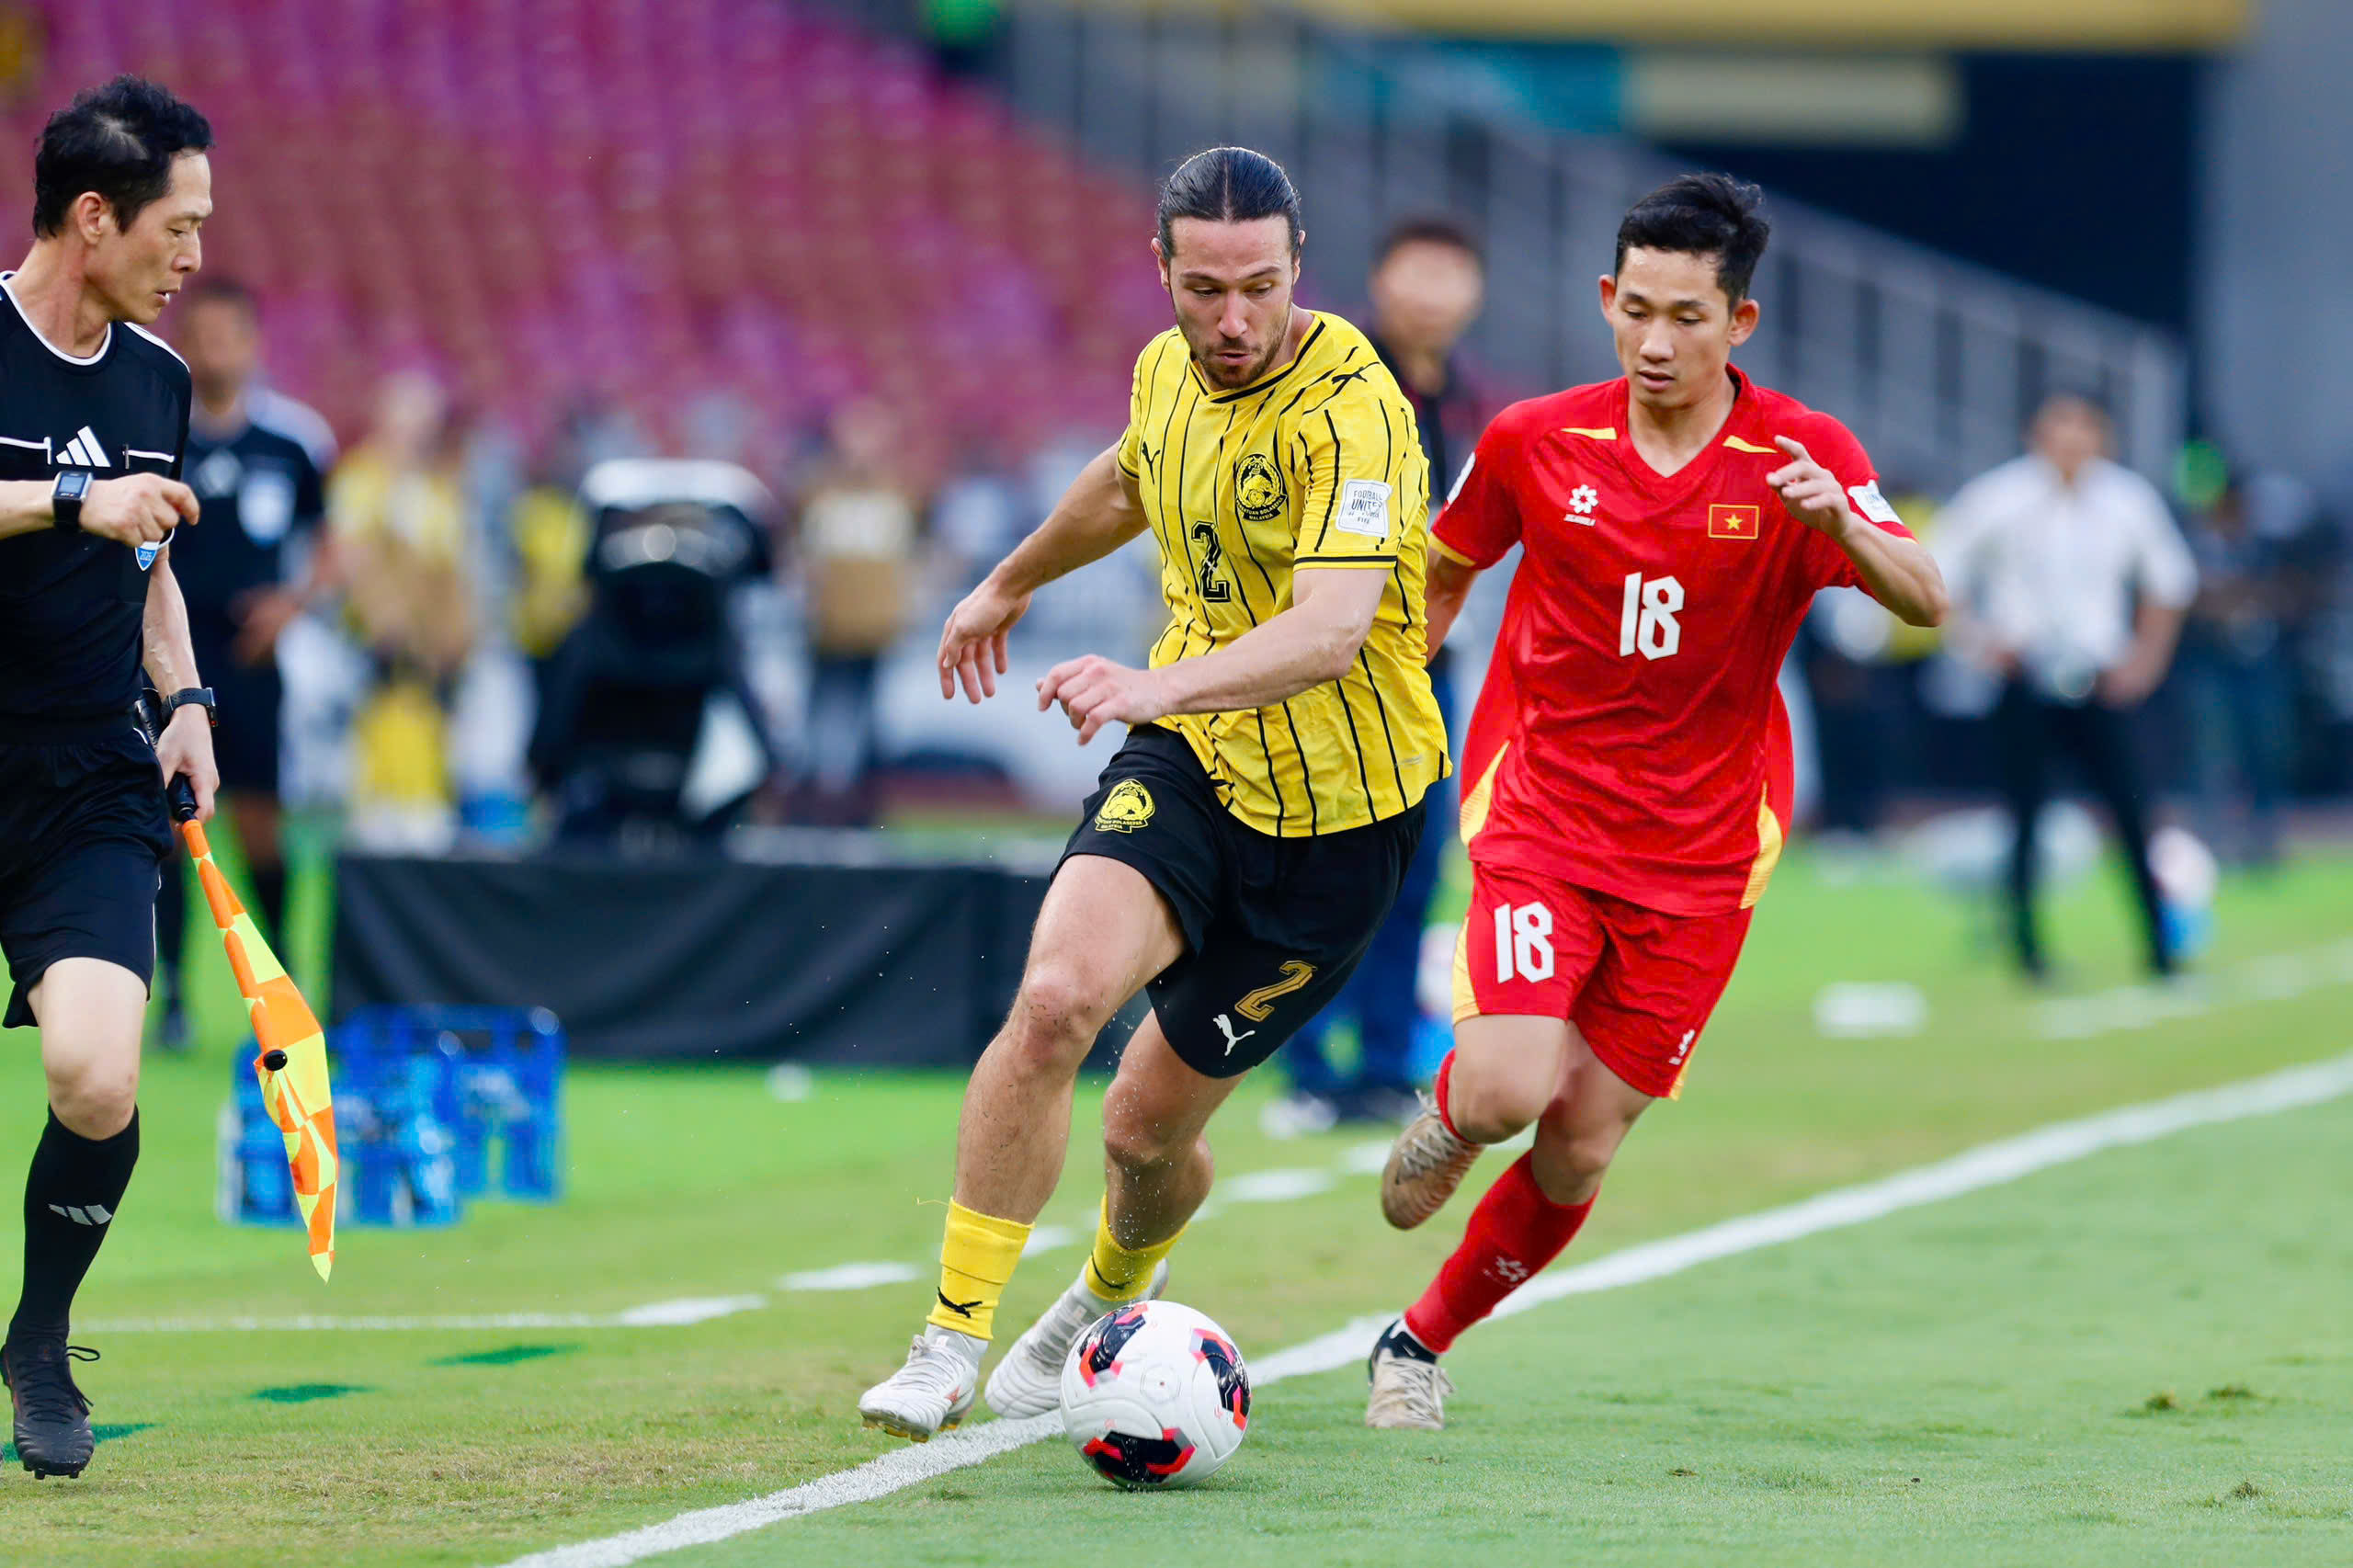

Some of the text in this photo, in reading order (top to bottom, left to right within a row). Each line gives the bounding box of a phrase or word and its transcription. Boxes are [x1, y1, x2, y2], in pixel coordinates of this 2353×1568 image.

[1191, 521, 1232, 603] 2
[1620, 572, 1685, 661] 18
[1495, 901, 1555, 984] 18
[1234, 960, 1317, 1022] 2
